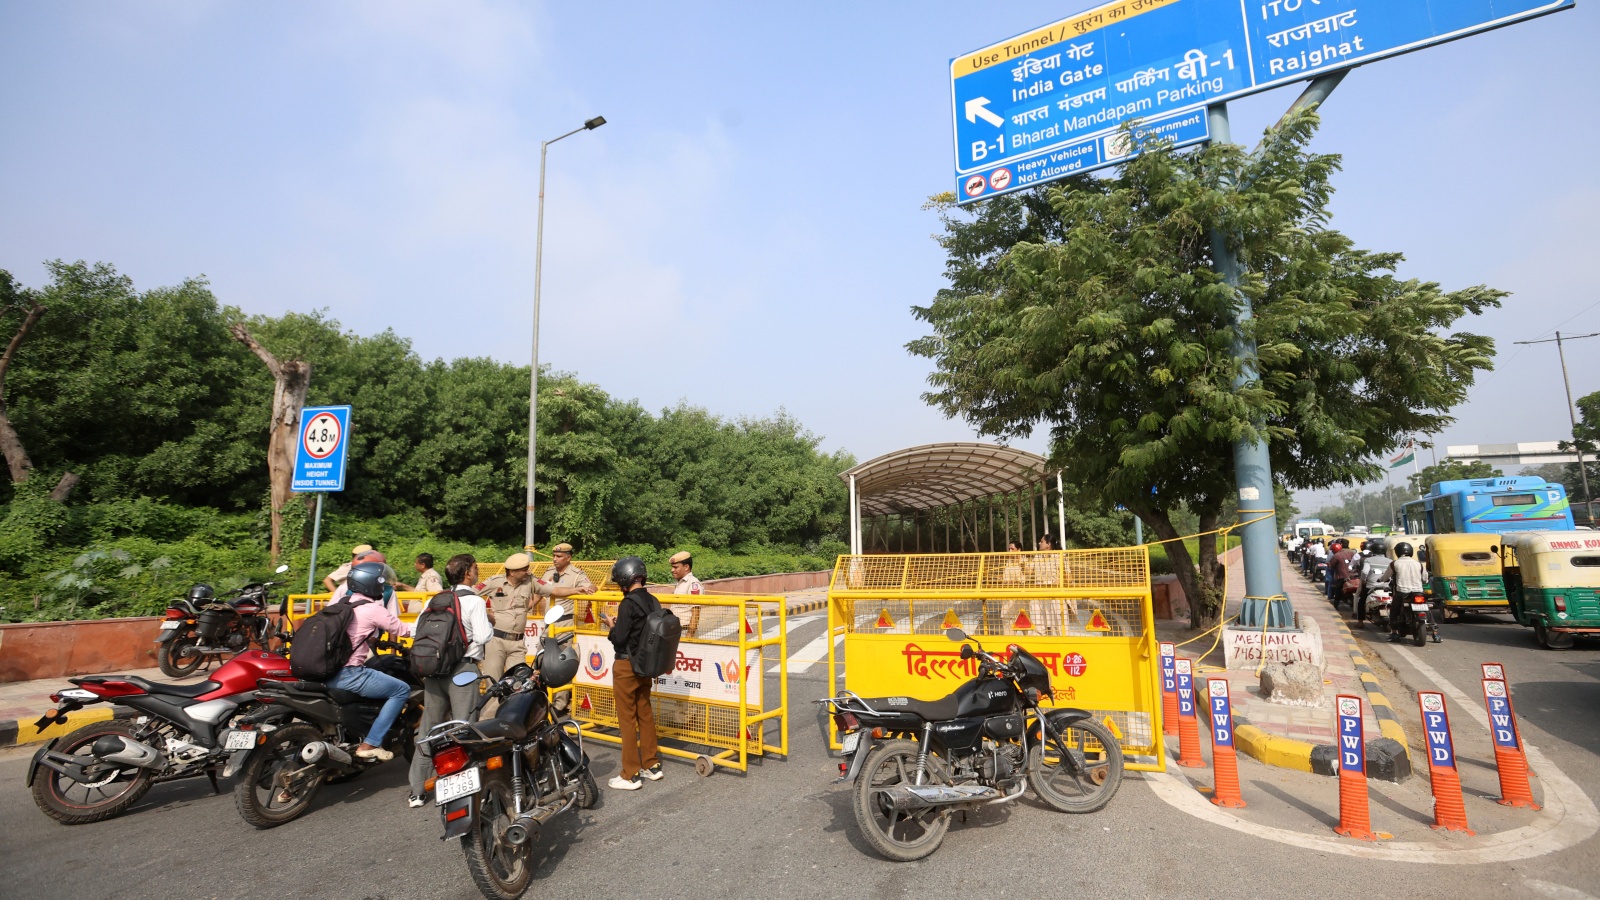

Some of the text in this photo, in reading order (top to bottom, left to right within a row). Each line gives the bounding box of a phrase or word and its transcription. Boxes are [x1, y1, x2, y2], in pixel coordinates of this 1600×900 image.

[1261, 0, 1302, 20] ITO
[1265, 9, 1358, 48] राजघाट
[973, 53, 999, 69] Use
[1004, 31, 1054, 58] Tunnel
[1060, 26, 1065, 41] /
[1072, 13, 1103, 33] सुरंग
[1108, 5, 1126, 19] का
[1269, 35, 1364, 75] Rajghat
[1011, 42, 1094, 82] इंडिया गेट
[1012, 63, 1103, 102] India Gate
[1012, 48, 1234, 126] भारत मंडपम पार्किंग बी-1
[972, 77, 1223, 161] B-1 Bharat Mandapam Parking
[1017, 145, 1093, 173] Heavy Vehicles
[1018, 160, 1082, 184] Not Allowed
[1235, 634, 1299, 645] MECHANIC
[1164, 658, 1175, 688] PWD
[1179, 676, 1192, 711] PWD
[1214, 699, 1229, 740] PWD
[1429, 715, 1449, 760] PWD
[1492, 700, 1512, 742] PWD
[1342, 719, 1360, 765] PWD
[444, 780, 474, 798] P1369
